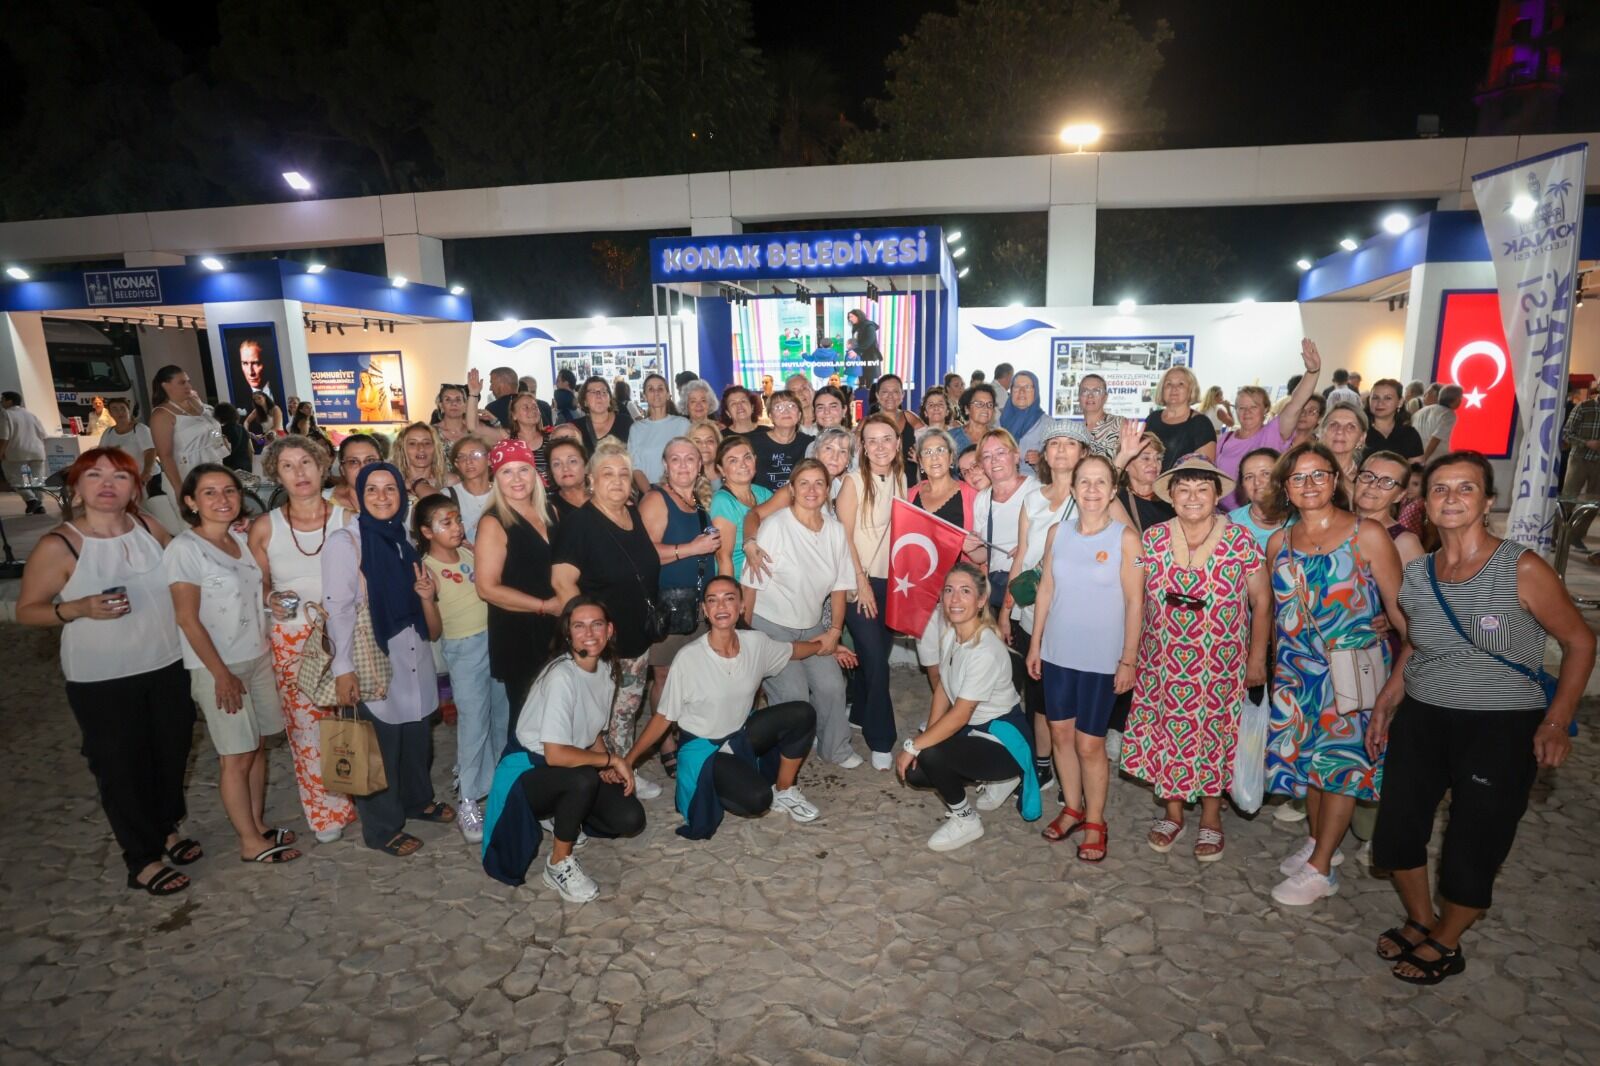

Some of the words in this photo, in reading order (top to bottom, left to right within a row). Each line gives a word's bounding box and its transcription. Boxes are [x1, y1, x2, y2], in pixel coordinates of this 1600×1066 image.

[663, 244, 762, 273] KONAK
[767, 230, 926, 268] BELEDİYESİ
[112, 275, 156, 289] KONAK
[311, 369, 354, 379] CUMHURİYET
[1107, 387, 1138, 395] ATIRIM
